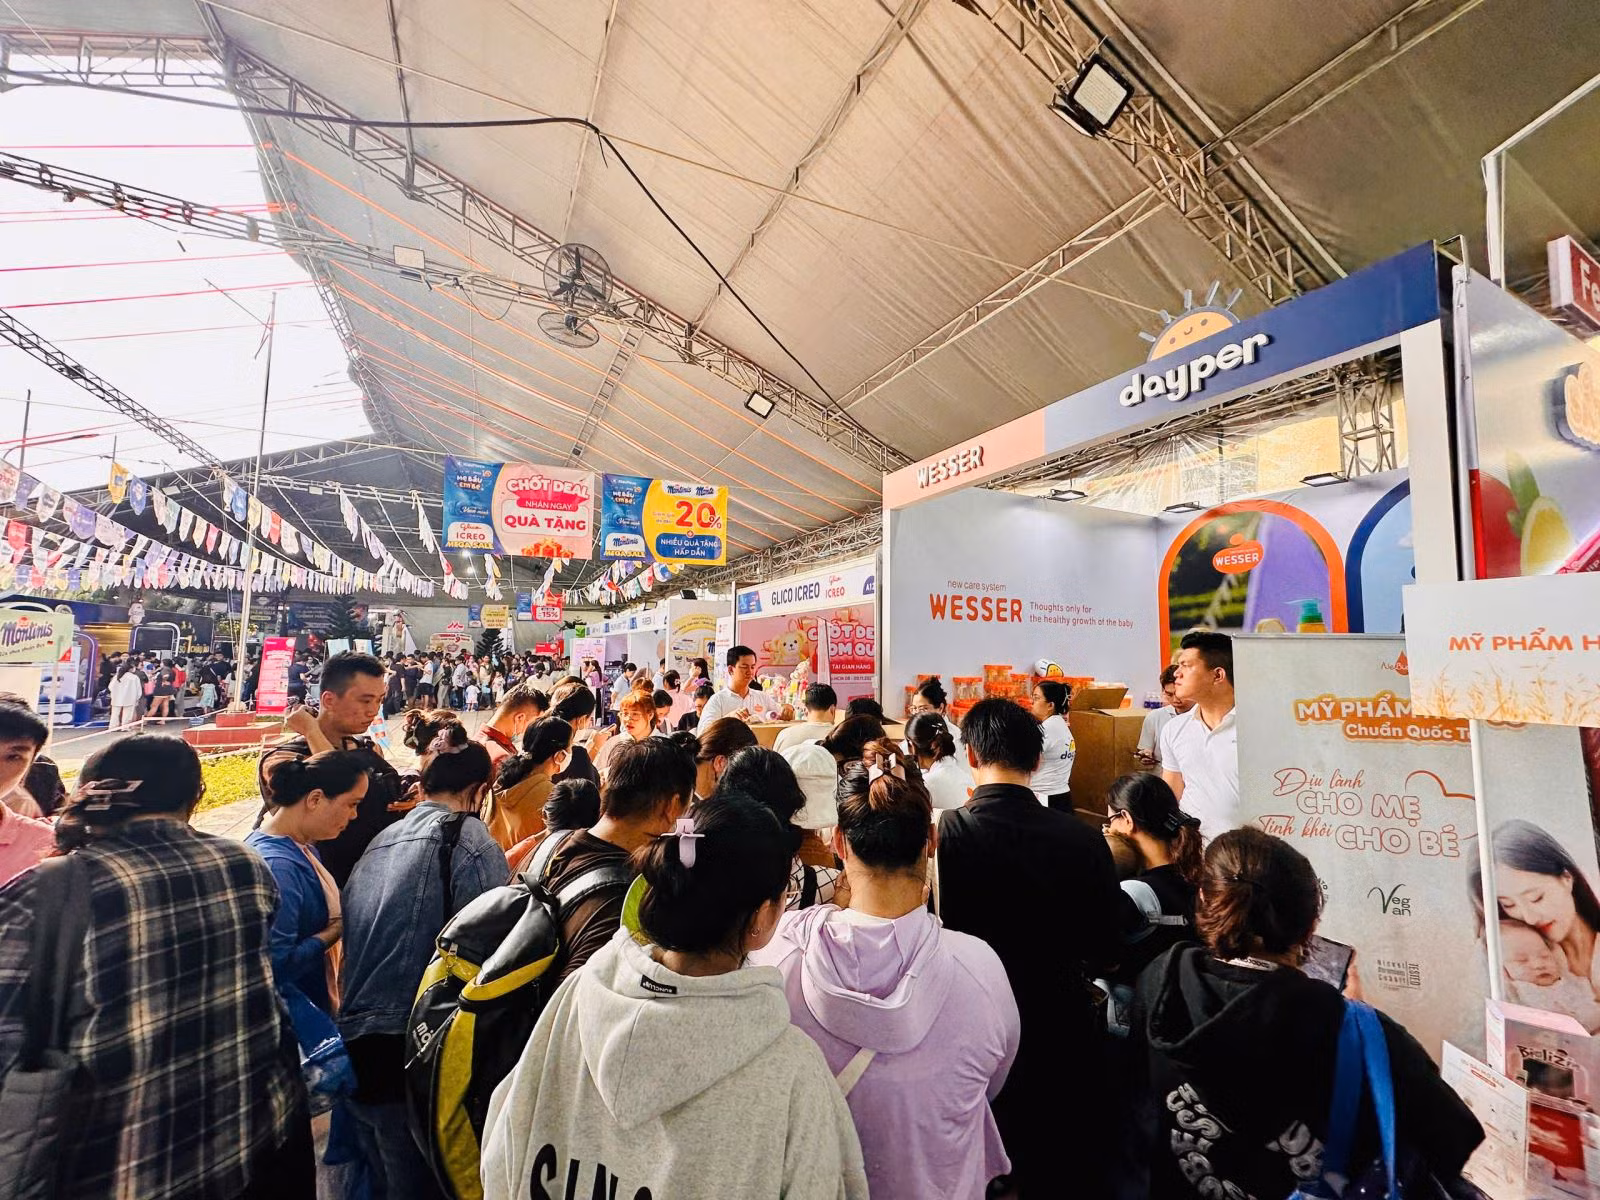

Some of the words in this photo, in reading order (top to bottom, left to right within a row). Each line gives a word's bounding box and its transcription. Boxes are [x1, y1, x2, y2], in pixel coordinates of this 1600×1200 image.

[1119, 333, 1270, 407] dayper
[917, 445, 984, 489] WESSER
[507, 475, 551, 492] CHỐT
[553, 480, 590, 498] DEAL
[551, 502, 572, 510] NGAY
[675, 500, 722, 530] 20%
[504, 514, 540, 528] QUÀ
[545, 515, 586, 532] TẶNG
[456, 532, 486, 540] ICREO
[684, 539, 700, 547] QUÀ
[674, 547, 689, 556] HẤP
[690, 548, 706, 556] DẪN
[1215, 552, 1259, 567] WESSER
[771, 587, 793, 605] GLICO
[794, 582, 820, 601] ICREO
[825, 586, 845, 599] ICREO
[947, 580, 962, 589] new
[964, 581, 980, 590] care
[981, 583, 1007, 593] system
[930, 593, 1022, 623] WESSER
[1030, 601, 1063, 613] Thoughts
[1066, 604, 1081, 614] only
[1082, 605, 1092, 613] for
[807, 618, 854, 641] CỐT
[1029, 614, 1042, 623] the
[1043, 615, 1070, 626] healthy
[1072, 617, 1096, 627] growth
[1106, 618, 1117, 626] the
[1118, 619, 1134, 629] baby
[1, 621, 53, 647] Montinis
[1449, 632, 1486, 651] MỸ
[1492, 627, 1573, 651] PHẨM
[816, 641, 853, 657] OM
[1296, 697, 1336, 719] MỸ
[1340, 693, 1413, 719] PHẨM
[1345, 721, 1403, 737] Chuẩn
[1407, 724, 1453, 740] Quốc
[1272, 767, 1323, 797] Dịu
[1330, 769, 1365, 789] lành
[1296, 789, 1363, 816] CHO
[1371, 793, 1421, 827] MẸ
[1301, 817, 1334, 838] khôi
[1335, 824, 1410, 854] CHO
[1418, 823, 1460, 858] BÉ
